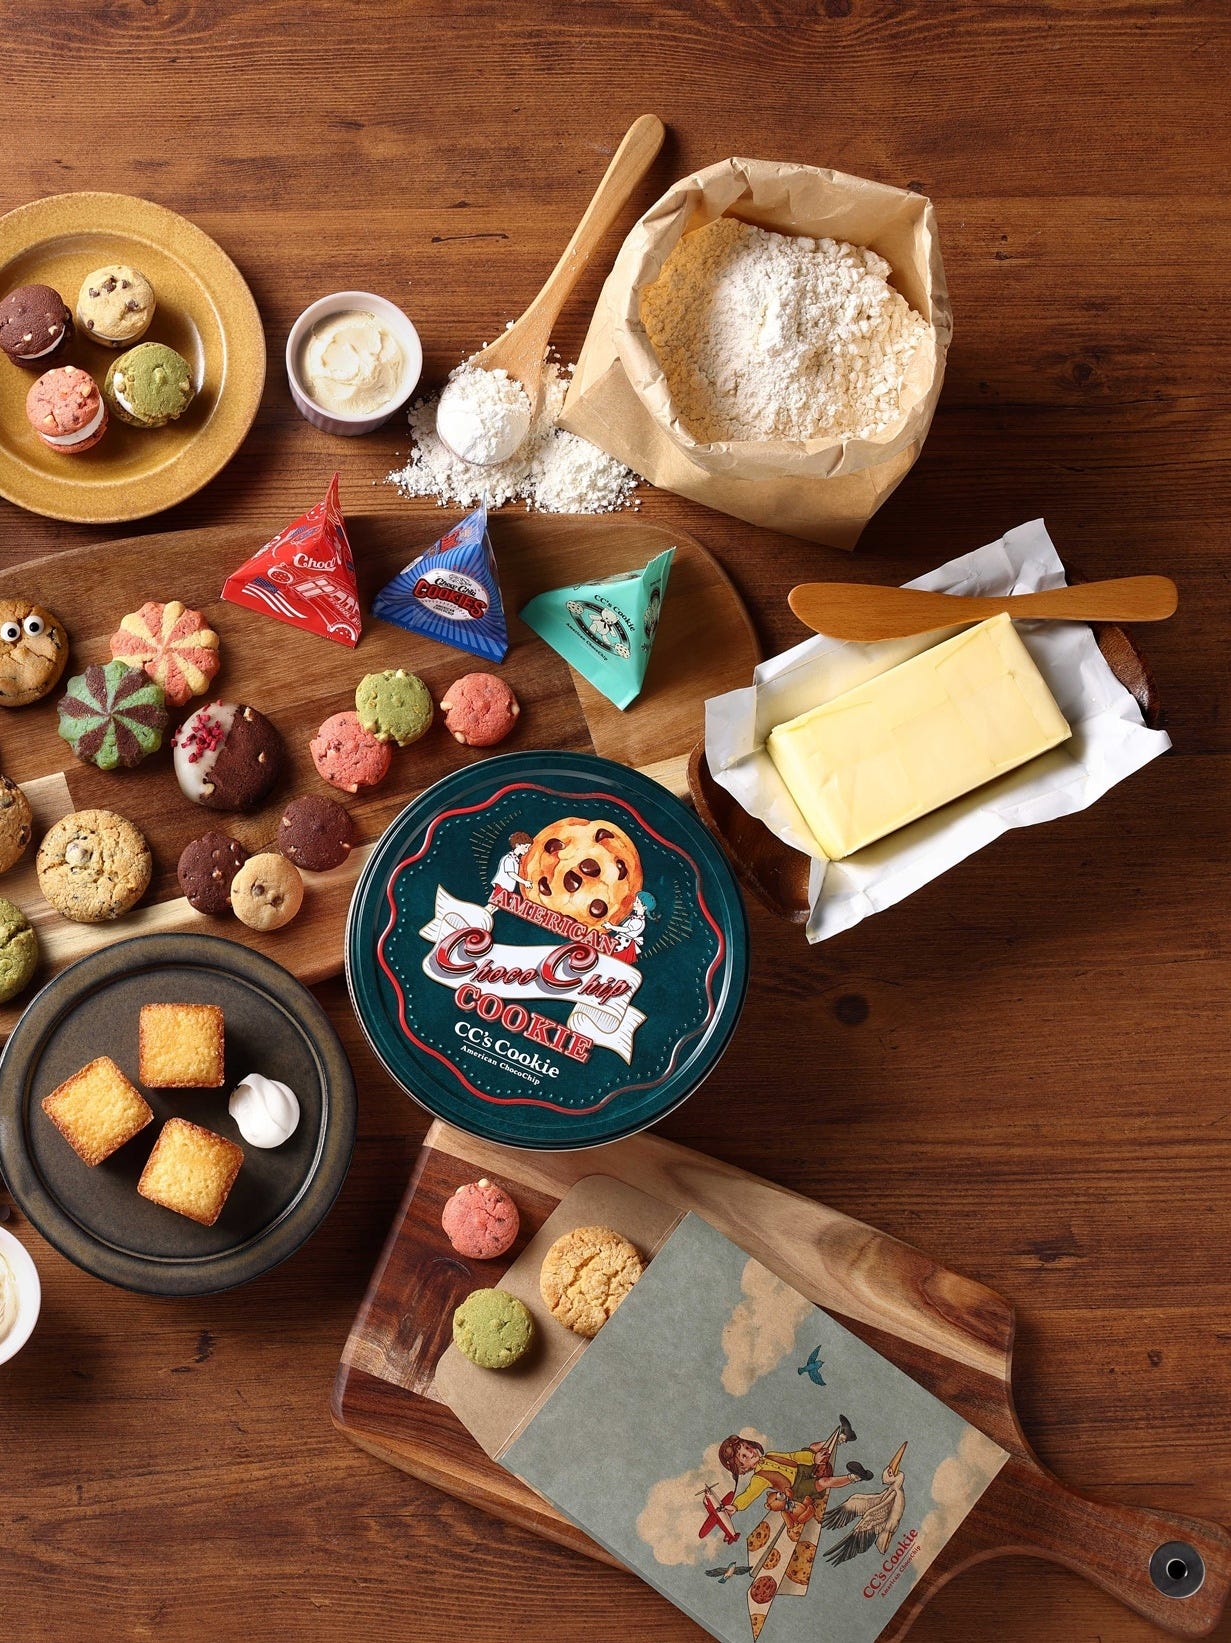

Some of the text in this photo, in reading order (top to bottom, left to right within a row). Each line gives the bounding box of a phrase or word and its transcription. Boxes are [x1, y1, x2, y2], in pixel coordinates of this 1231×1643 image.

[412, 578, 488, 620] COOKIES
[613, 607, 636, 632] Cookie
[492, 885, 619, 957] AMERICAN
[436, 926, 632, 1004] Choco Chip
[454, 982, 595, 1065] COOKIE
[454, 1021, 561, 1080] CC's Cookie
[460, 1045, 541, 1086] American ChocoChip
[863, 1529, 919, 1598] CC's Cookie
